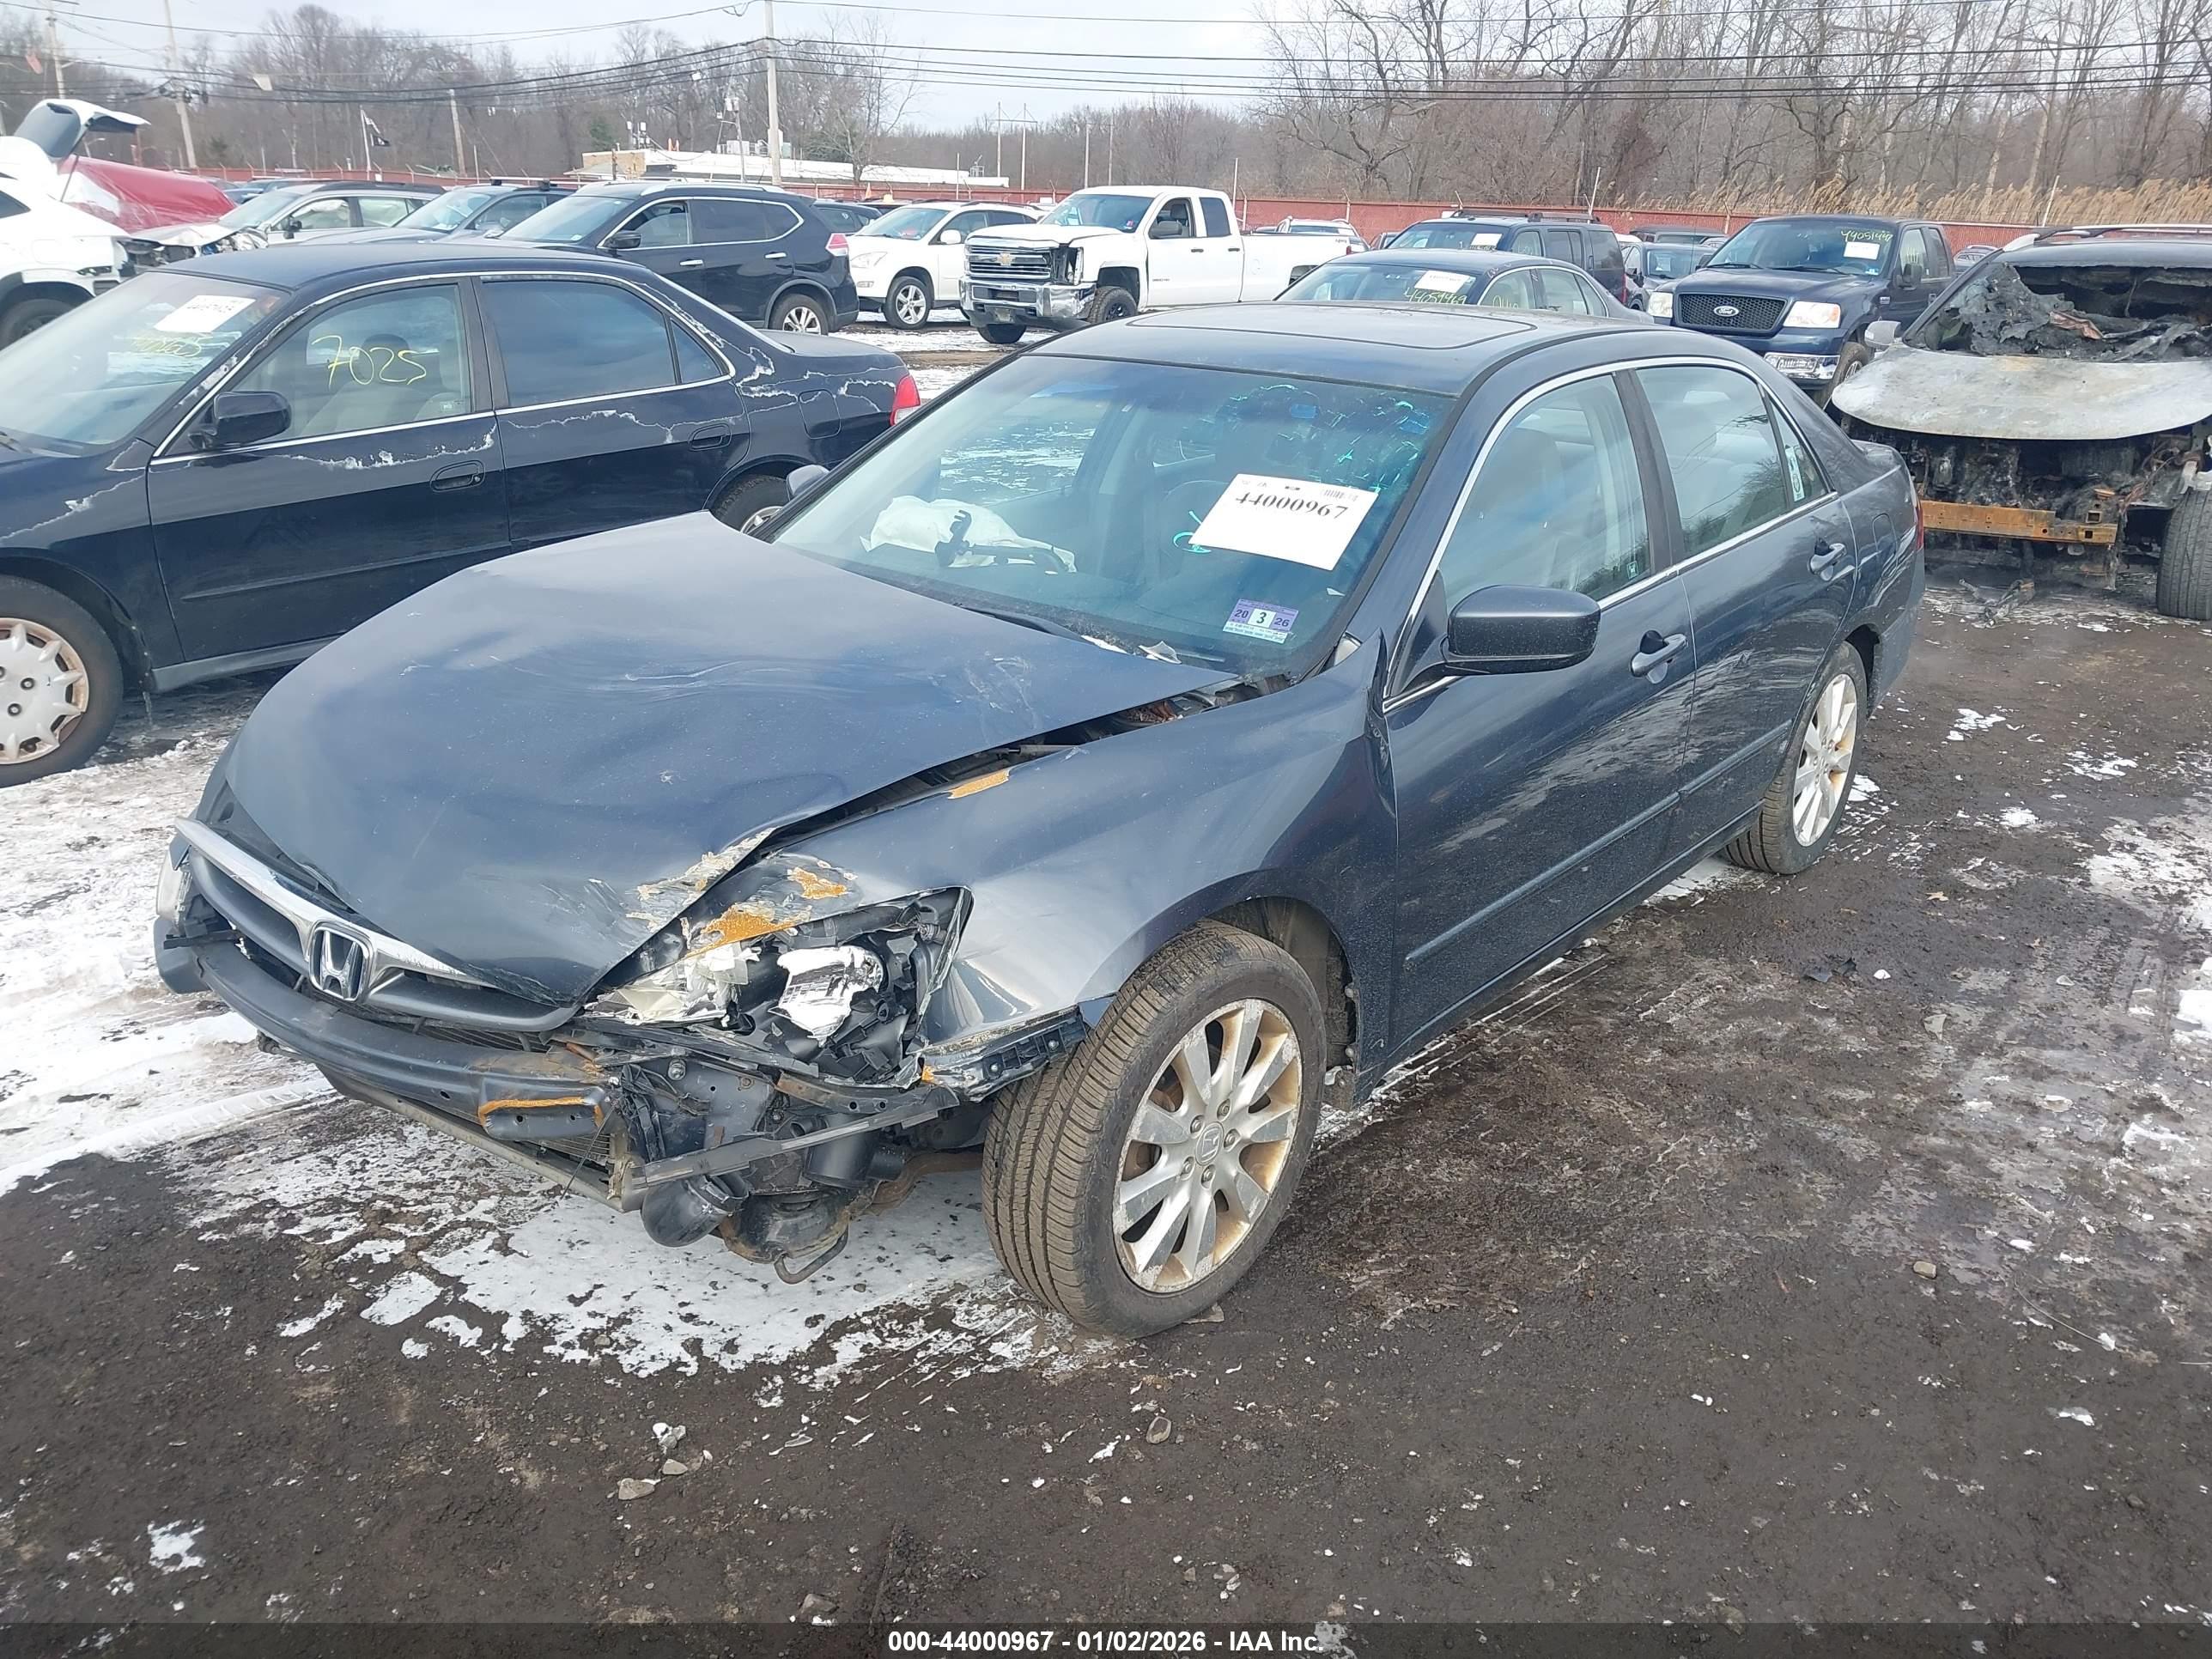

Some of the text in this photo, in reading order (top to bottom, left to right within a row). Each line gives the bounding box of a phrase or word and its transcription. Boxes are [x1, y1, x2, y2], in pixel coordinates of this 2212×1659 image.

[312, 334, 436, 390] 7025
[1236, 491, 1349, 519] 44000967
[1234, 609, 1290, 628] 20 3 26
